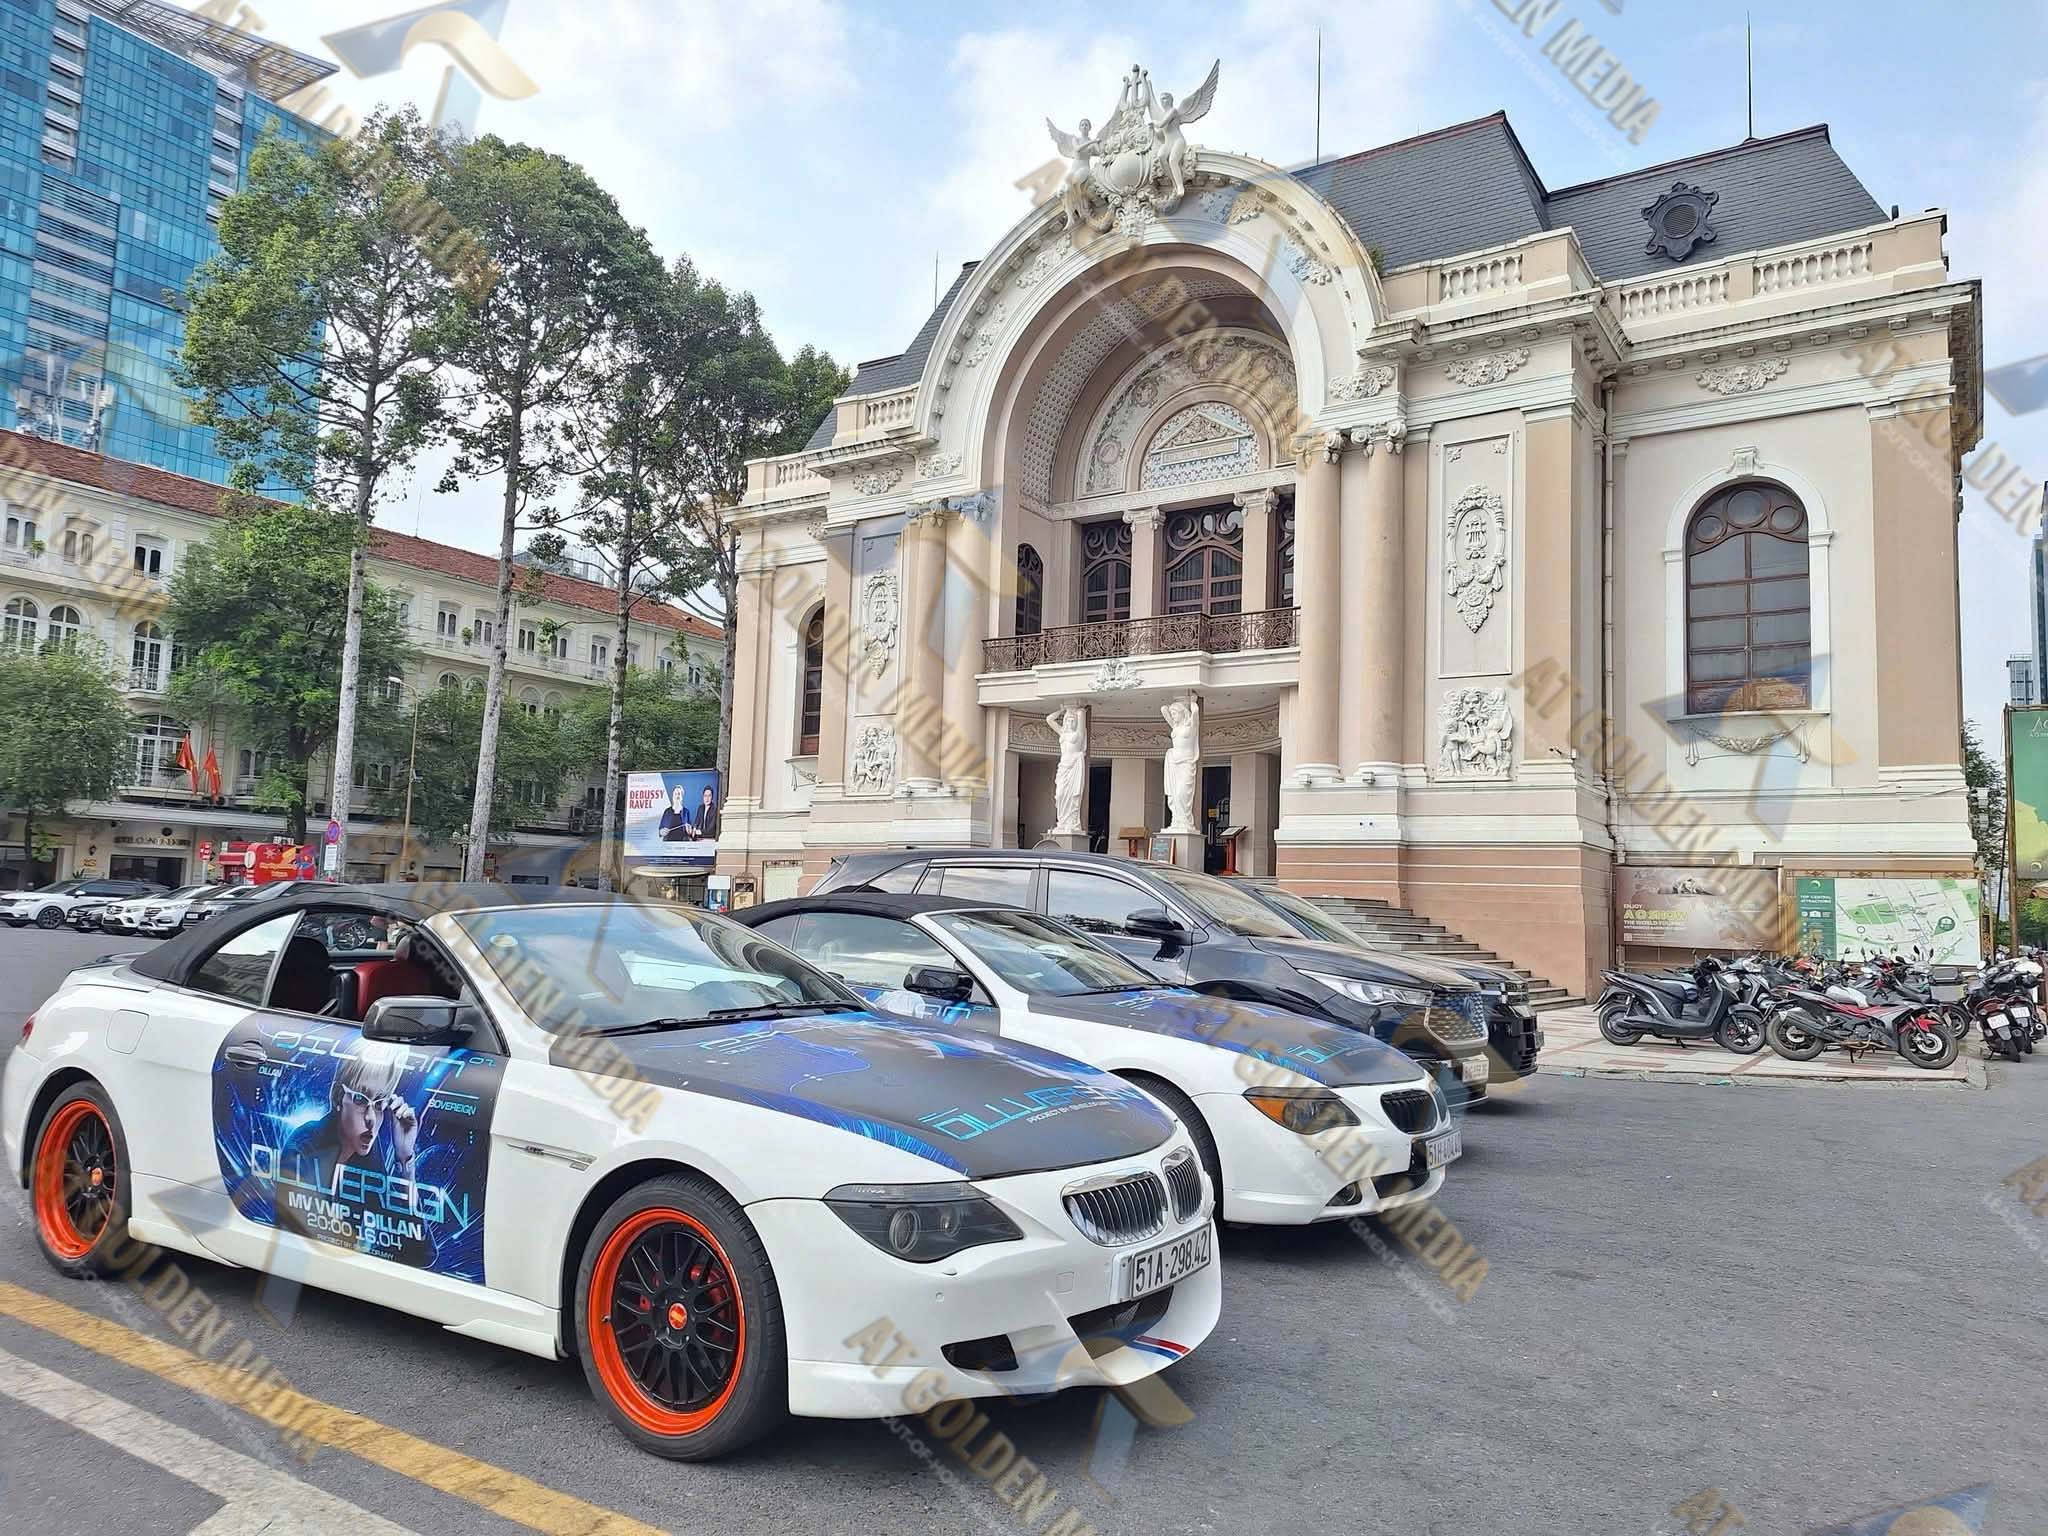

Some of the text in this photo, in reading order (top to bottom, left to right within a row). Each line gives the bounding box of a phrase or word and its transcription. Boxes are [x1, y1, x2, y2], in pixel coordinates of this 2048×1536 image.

[630, 789, 665, 799] DEBUSSY
[629, 800, 653, 809] RAVEL
[258, 1065, 282, 1078] DILLAN
[428, 1098, 477, 1116] SOVEREIGN
[288, 1191, 312, 1211] MV
[363, 1211, 422, 1241] DILLAN
[307, 1212, 402, 1250] 20:00 16.04
[1135, 1230, 1208, 1292] 51A-298.42
